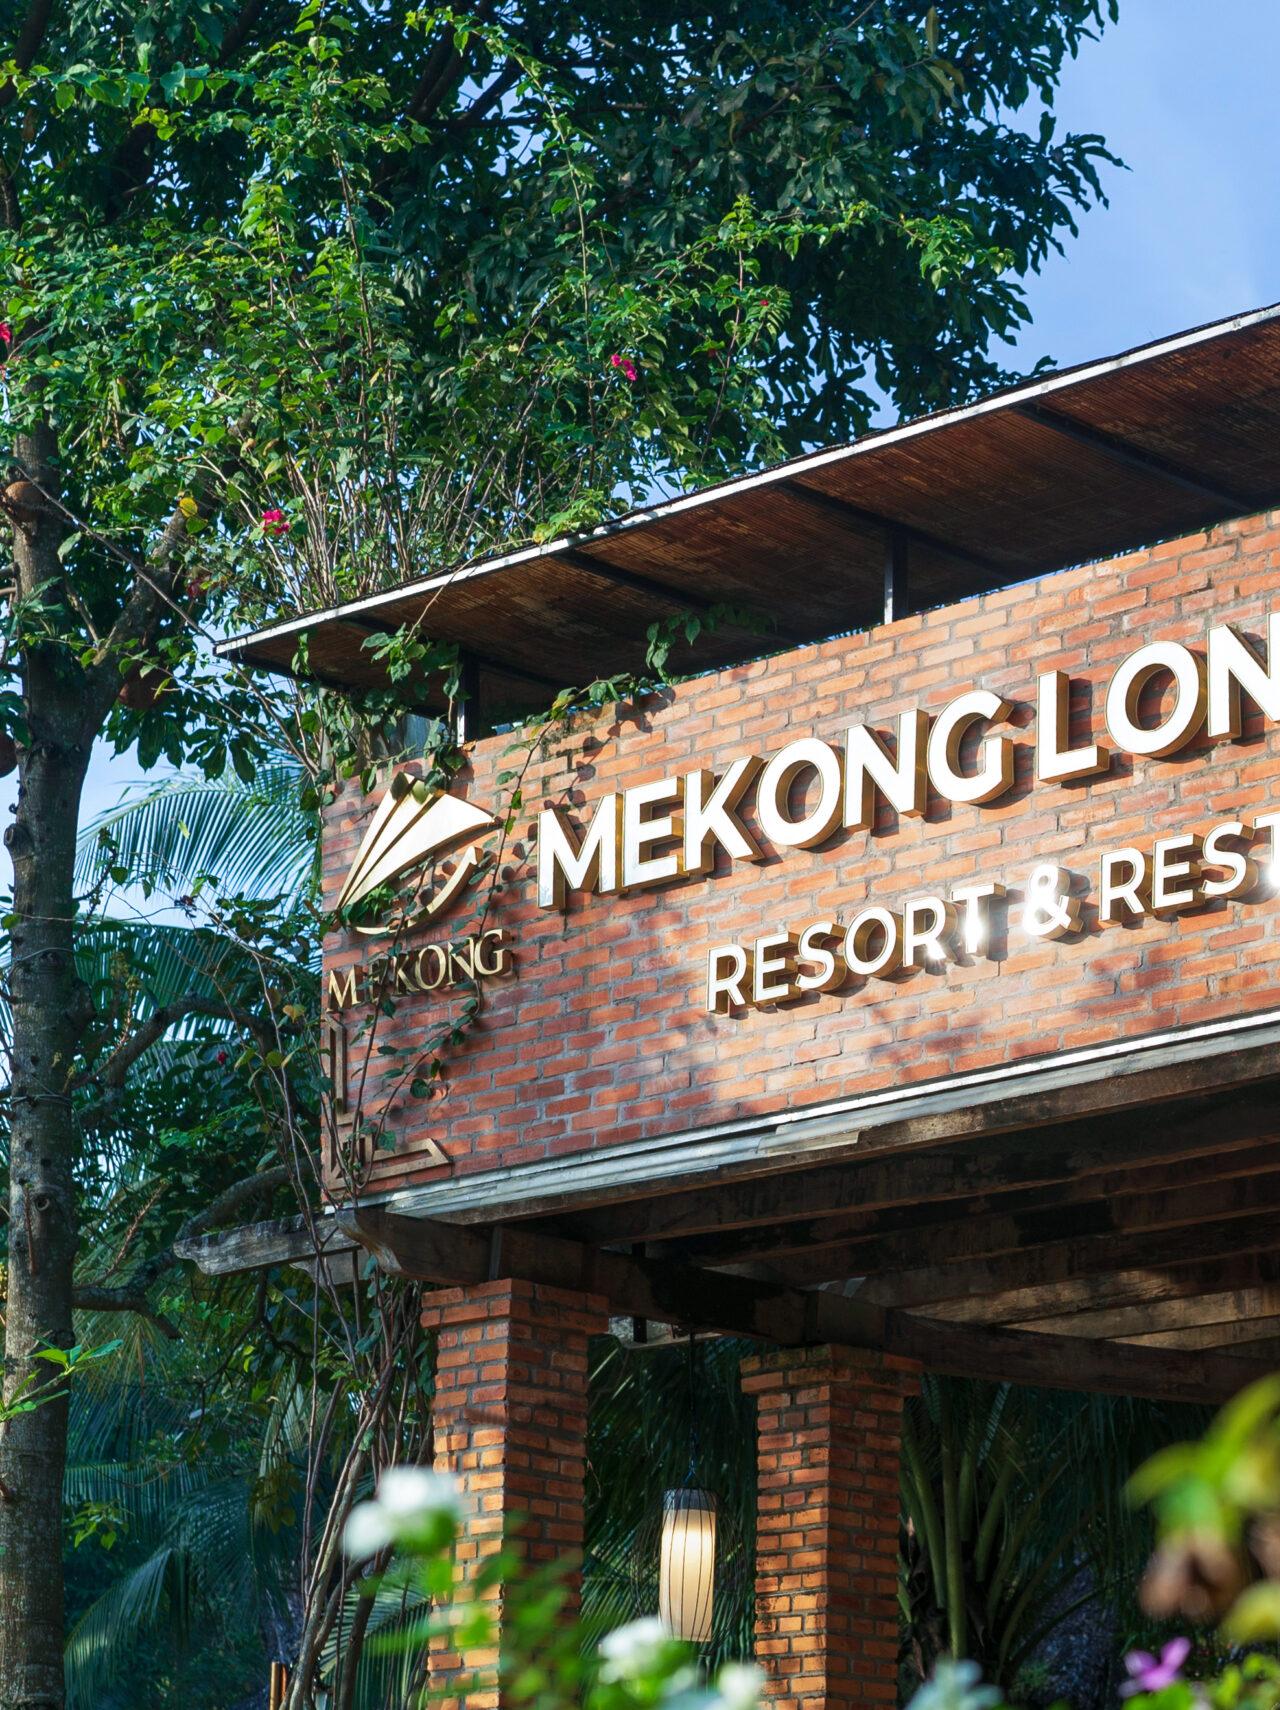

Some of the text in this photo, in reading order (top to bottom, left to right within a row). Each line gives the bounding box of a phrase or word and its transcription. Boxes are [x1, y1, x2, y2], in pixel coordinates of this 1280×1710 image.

[537, 689, 1014, 910] MEKONG
[706, 882, 1006, 1014] RESORT
[1021, 863, 1083, 941] &
